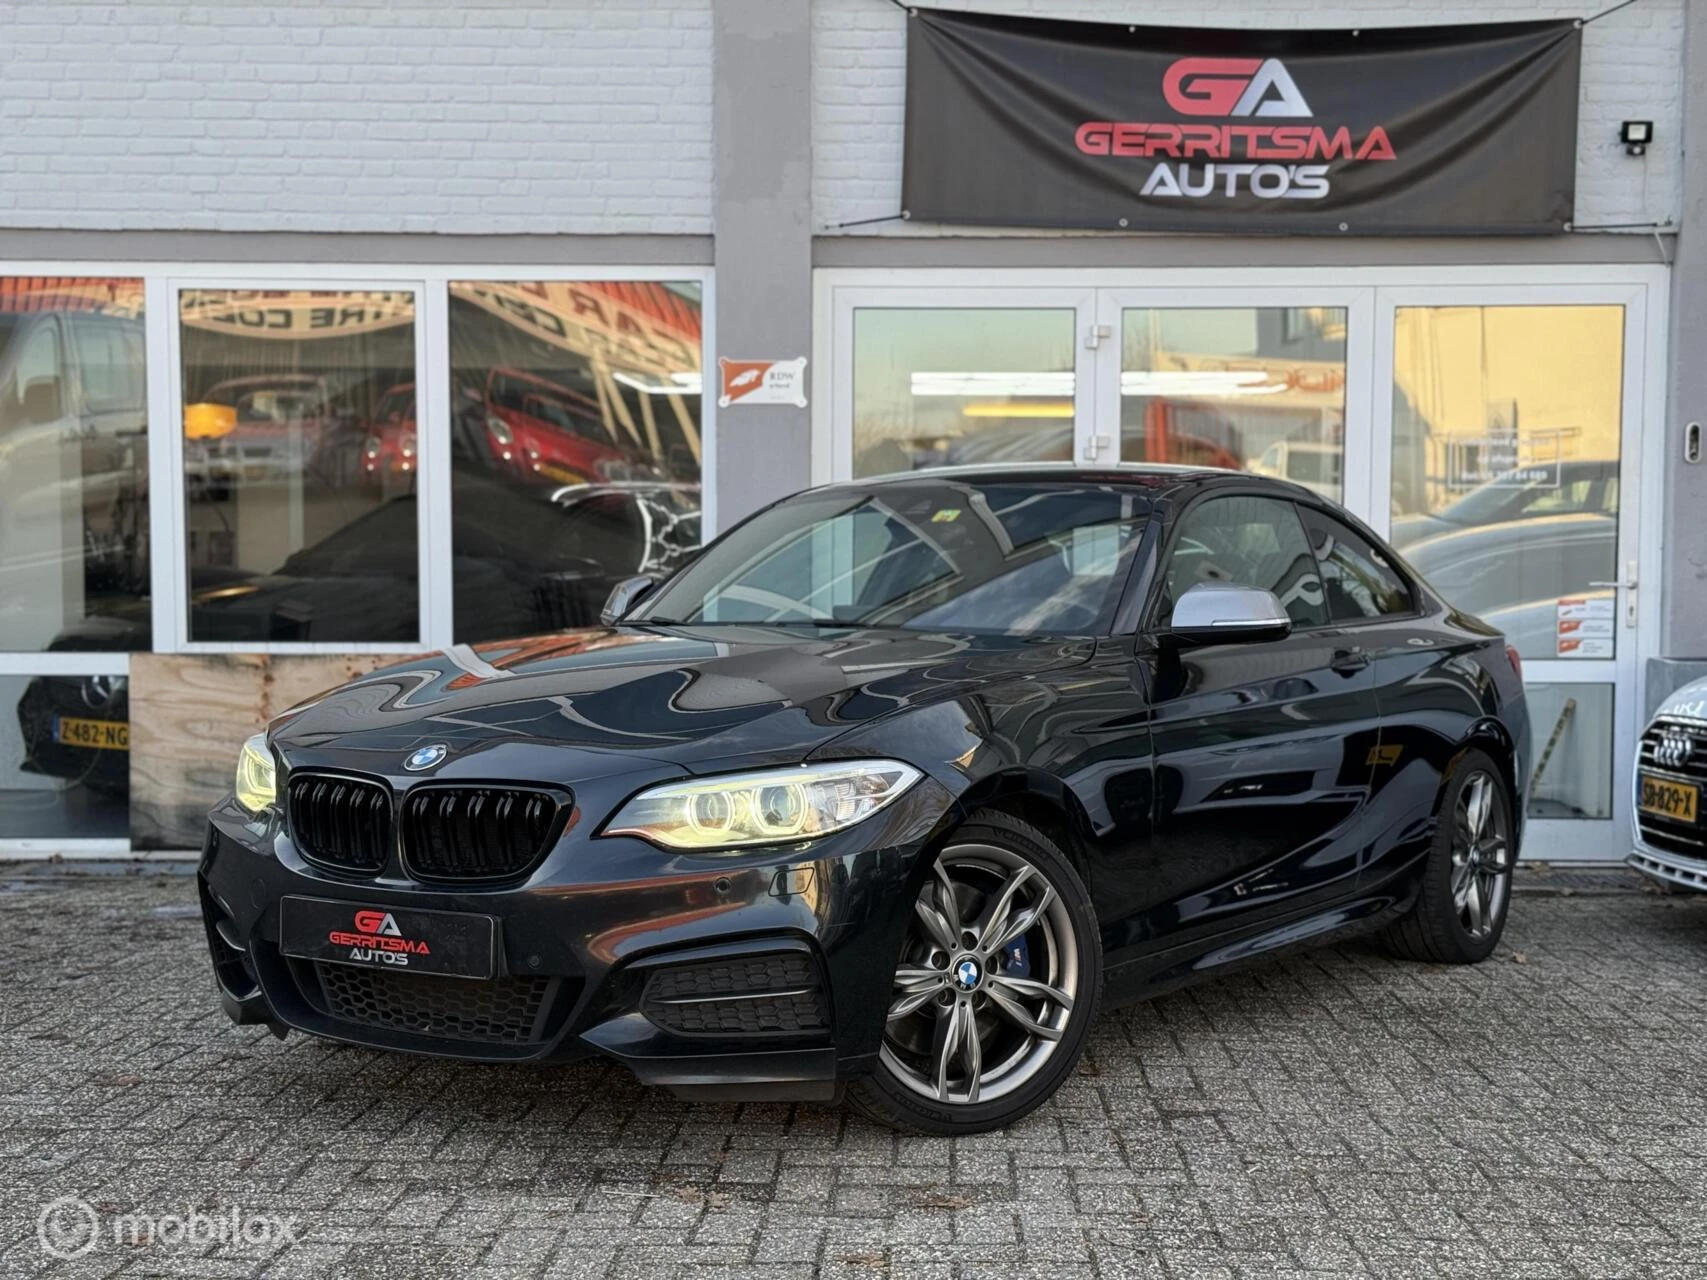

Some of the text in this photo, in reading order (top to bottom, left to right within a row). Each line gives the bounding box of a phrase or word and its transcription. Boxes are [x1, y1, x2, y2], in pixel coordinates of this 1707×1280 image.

[1163, 57, 1314, 117] GA
[1074, 122, 1397, 160] GERRITSMA
[1139, 162, 1331, 199] AUTO'S
[354, 910, 402, 937] GA
[329, 931, 431, 955] GERRITSMA
[348, 947, 409, 966] AUTO'S
